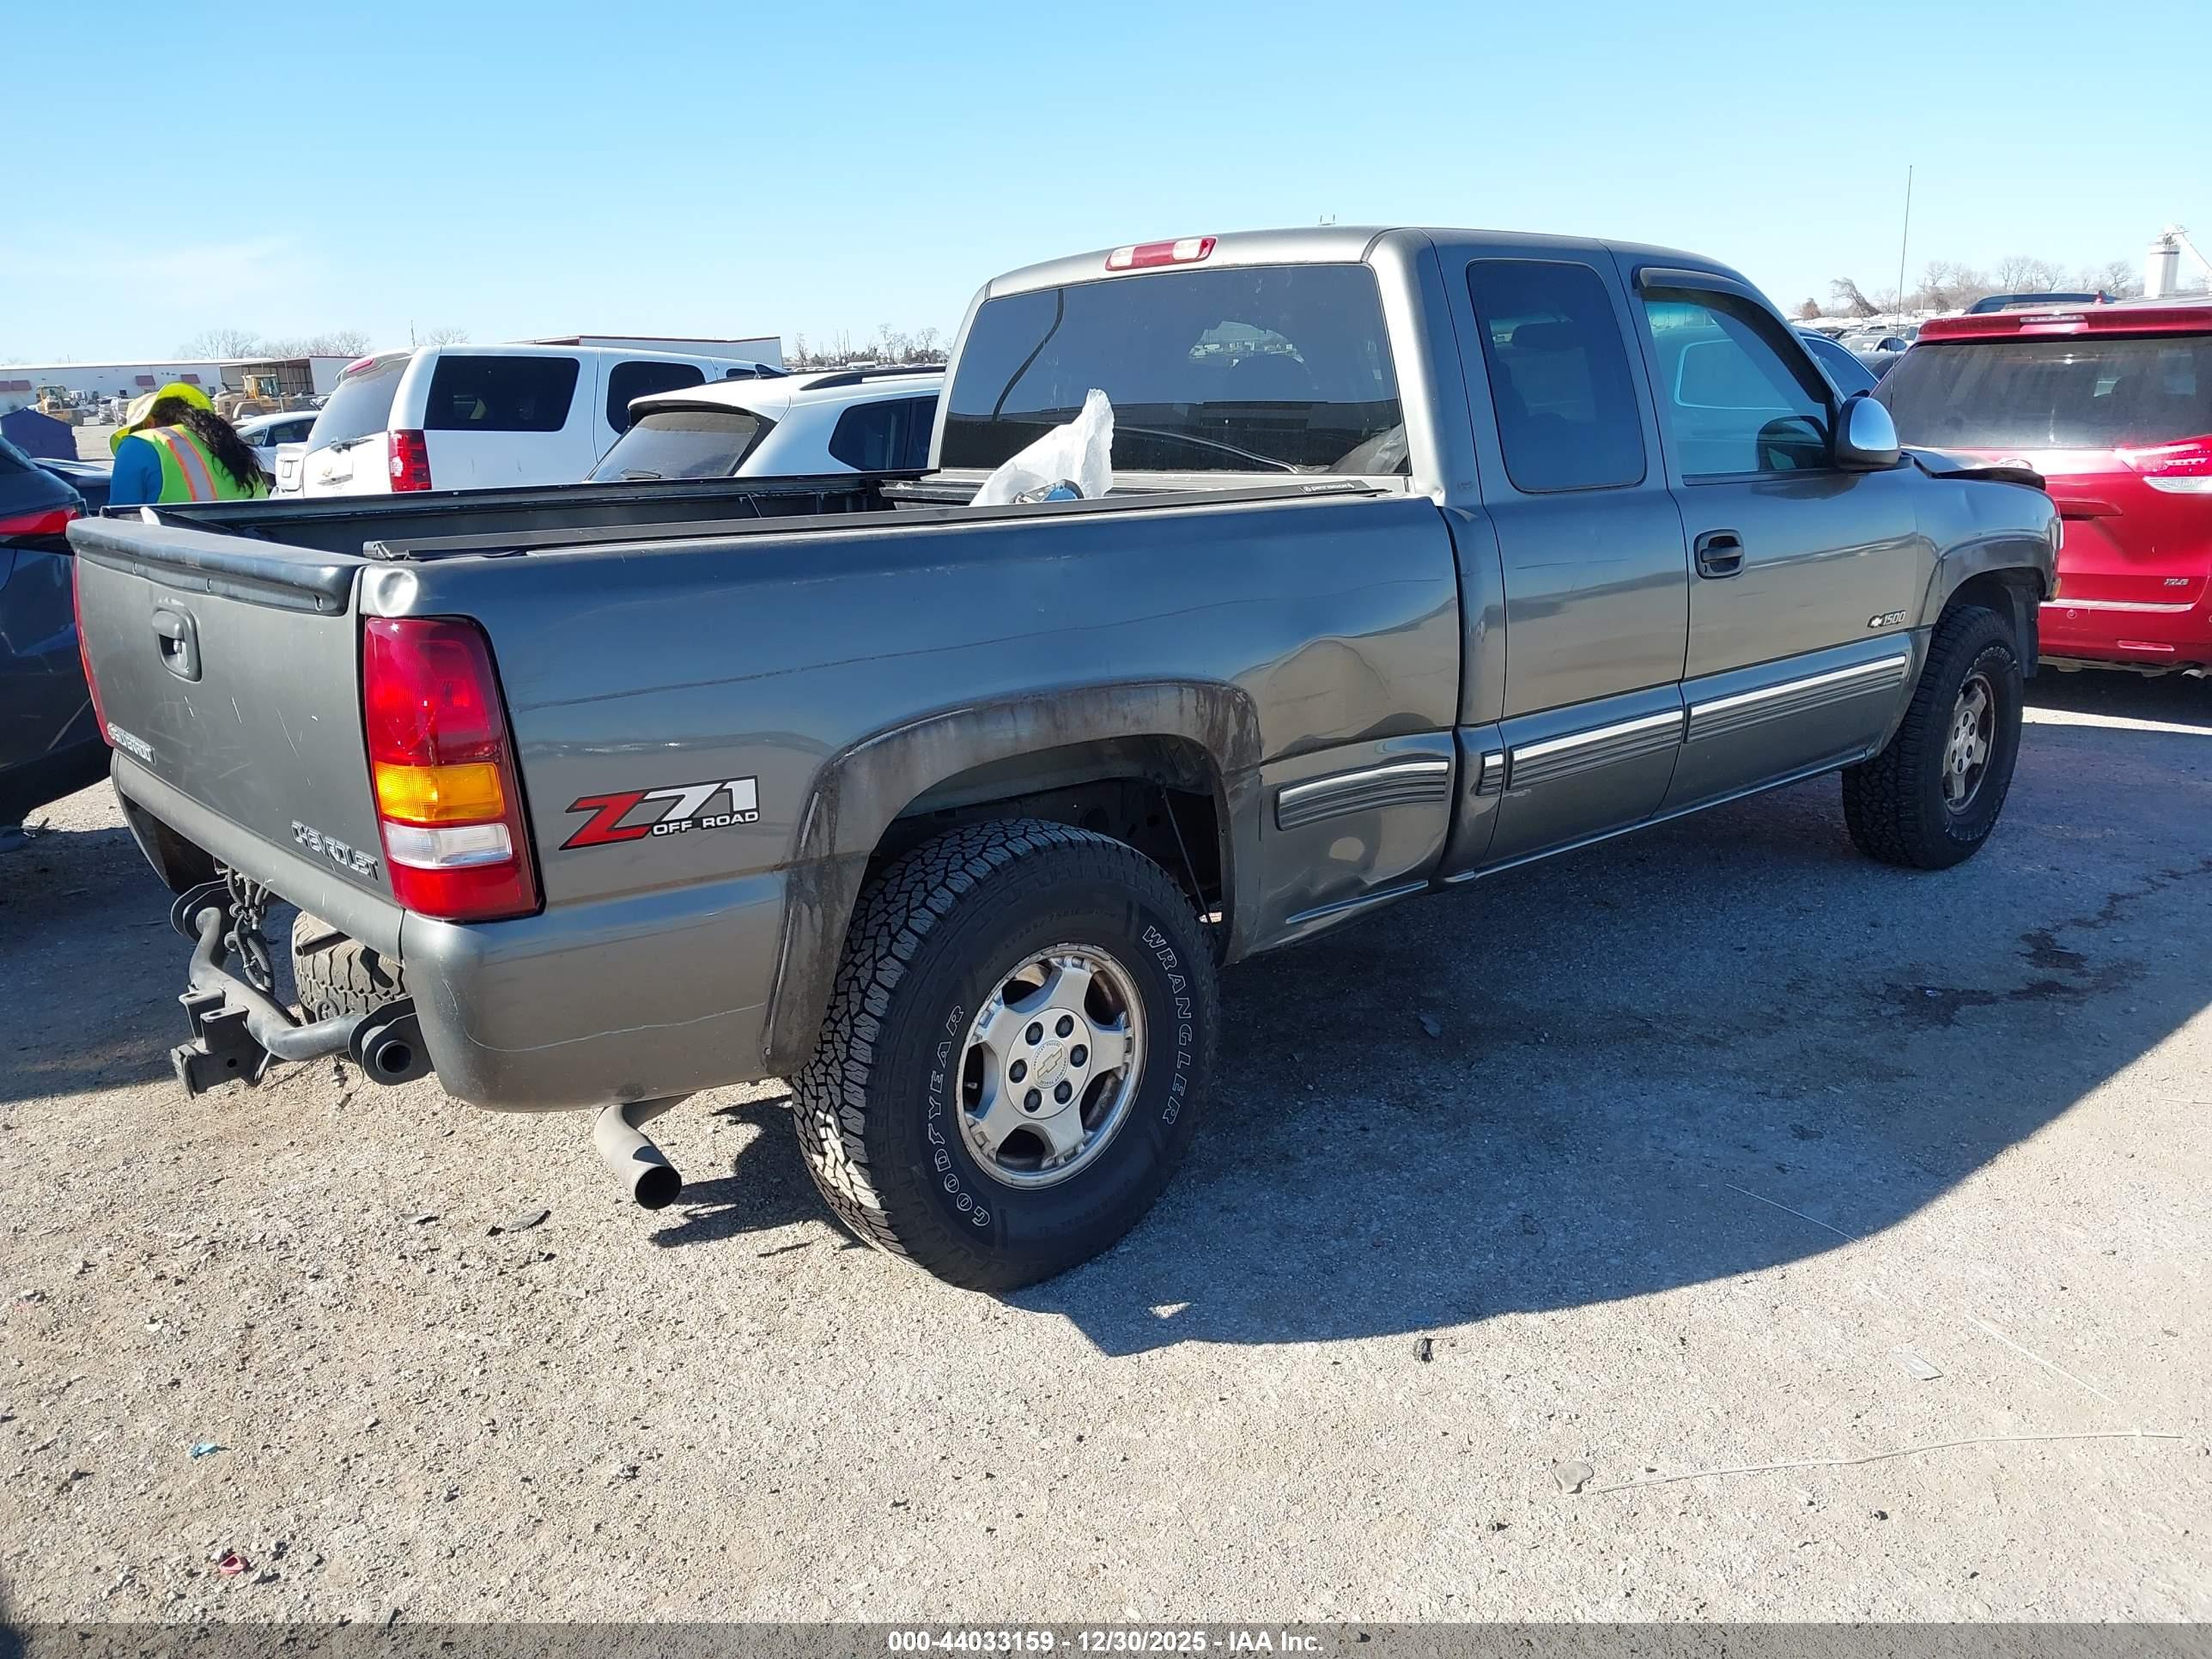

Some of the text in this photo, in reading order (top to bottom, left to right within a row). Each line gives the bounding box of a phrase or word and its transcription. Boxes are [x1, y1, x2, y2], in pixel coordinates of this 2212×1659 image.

[1882, 611, 1906, 626] 1500
[560, 775, 758, 850] Z71
[653, 811, 759, 836] OFF ROAD
[291, 819, 380, 881] CHEVROLET
[1141, 925, 1193, 1125] WRANGLER
[928, 1005, 991, 1227] GOODYEAR
